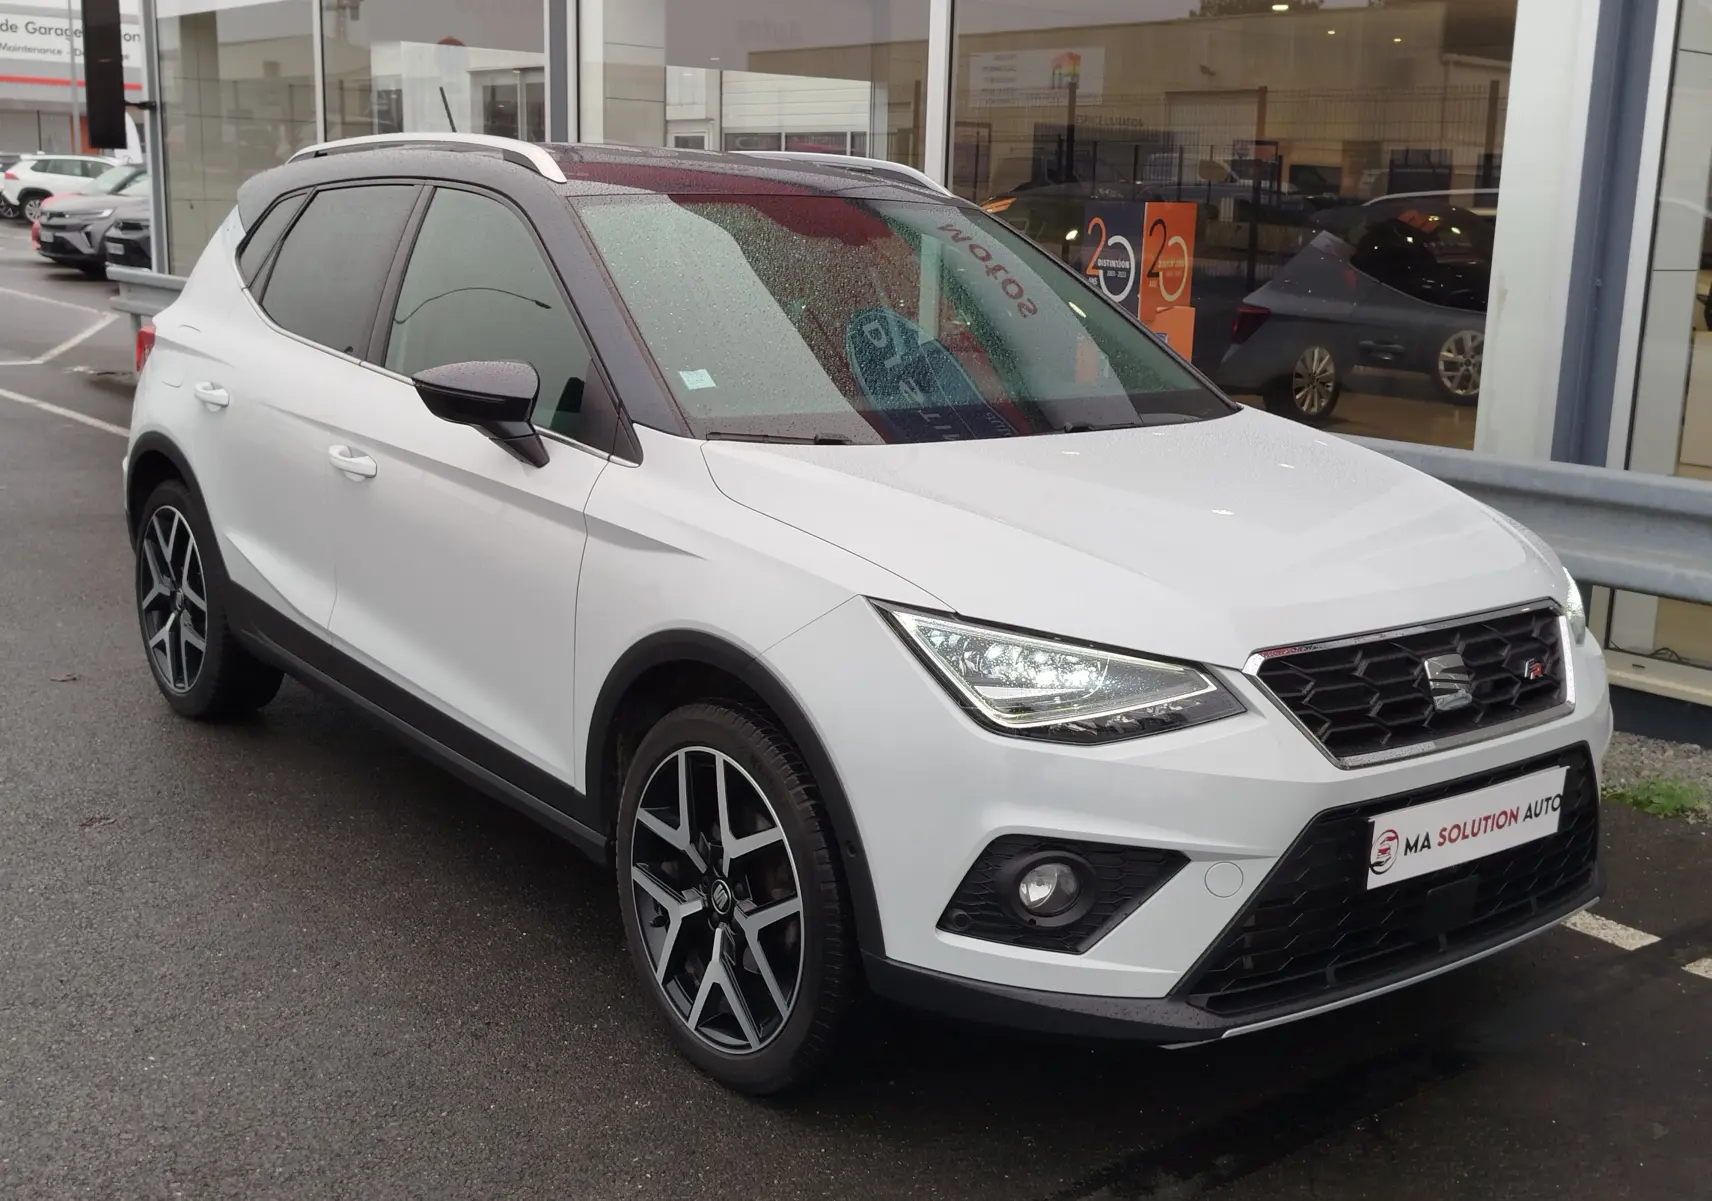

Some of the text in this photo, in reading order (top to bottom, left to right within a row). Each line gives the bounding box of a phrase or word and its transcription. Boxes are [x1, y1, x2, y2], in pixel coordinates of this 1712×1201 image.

[1403, 793, 1563, 856] MA SOLUTION AUTO
